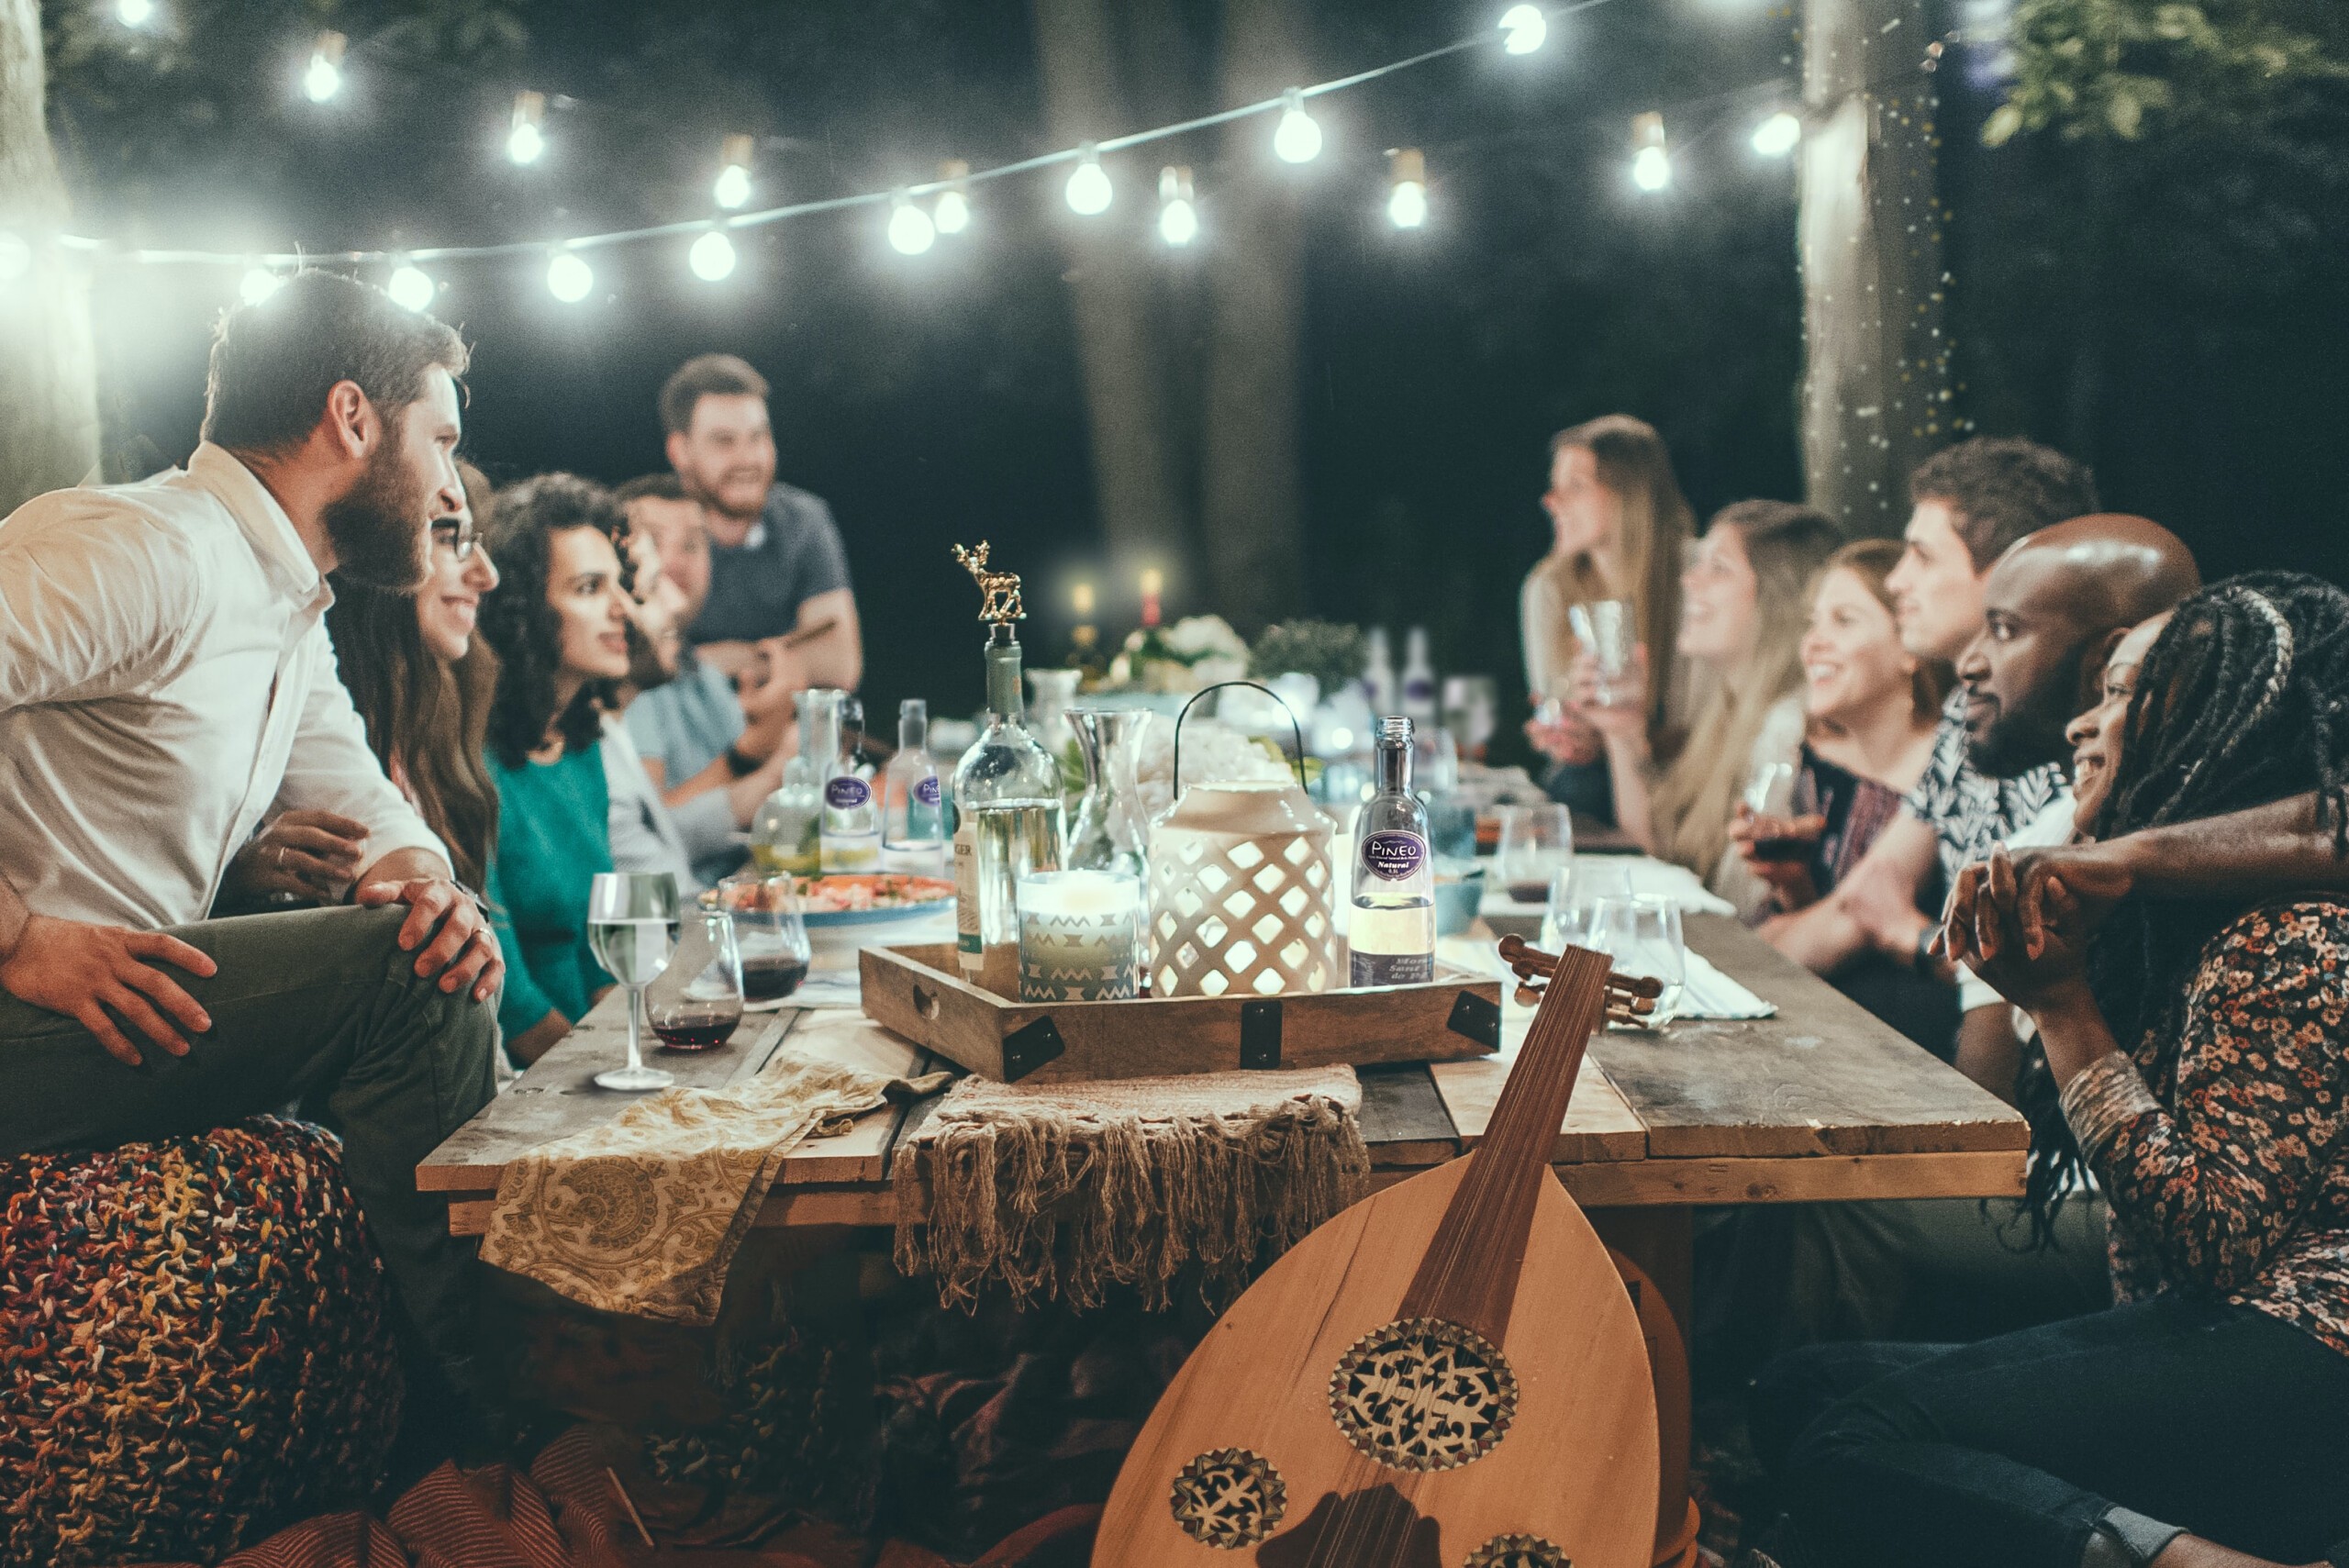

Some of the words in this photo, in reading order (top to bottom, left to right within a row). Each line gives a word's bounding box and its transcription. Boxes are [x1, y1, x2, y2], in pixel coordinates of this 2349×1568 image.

[830, 784, 863, 795] PINEO
[1372, 840, 1417, 857] PINEO
[1377, 861, 1409, 869] Natural
